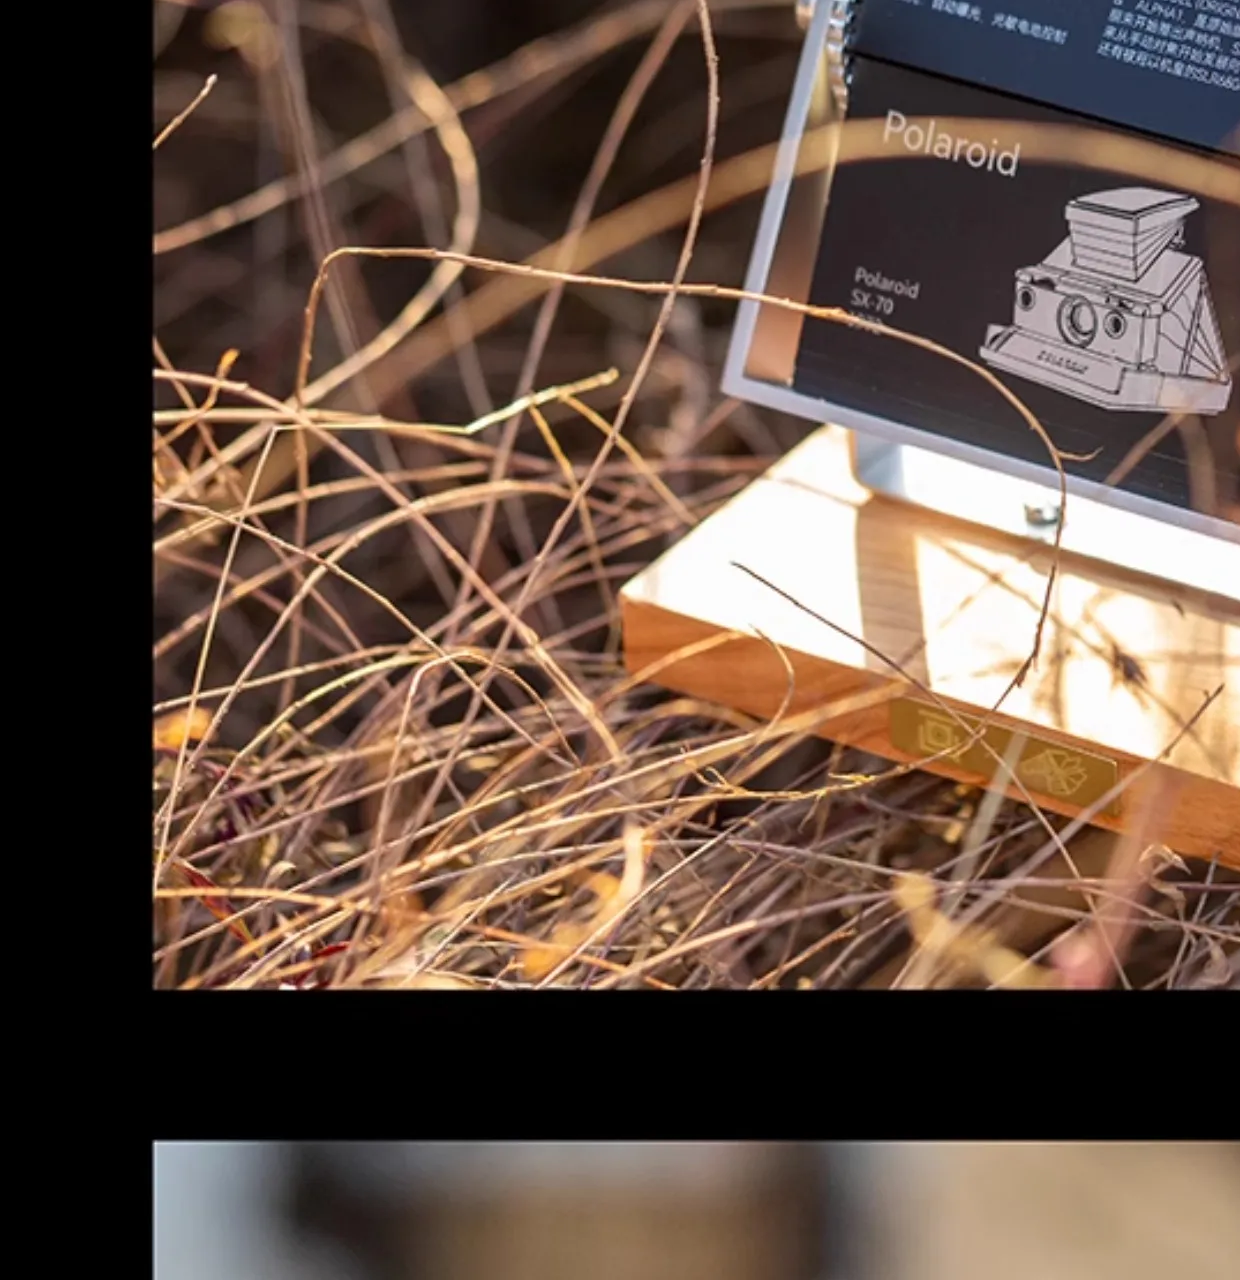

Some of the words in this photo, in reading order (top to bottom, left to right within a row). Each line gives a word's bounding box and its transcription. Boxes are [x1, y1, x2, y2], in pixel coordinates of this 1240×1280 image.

[882, 108, 1020, 177] Polaroid
[854, 266, 920, 299] Polaroid
[851, 289, 894, 316] SX-70
